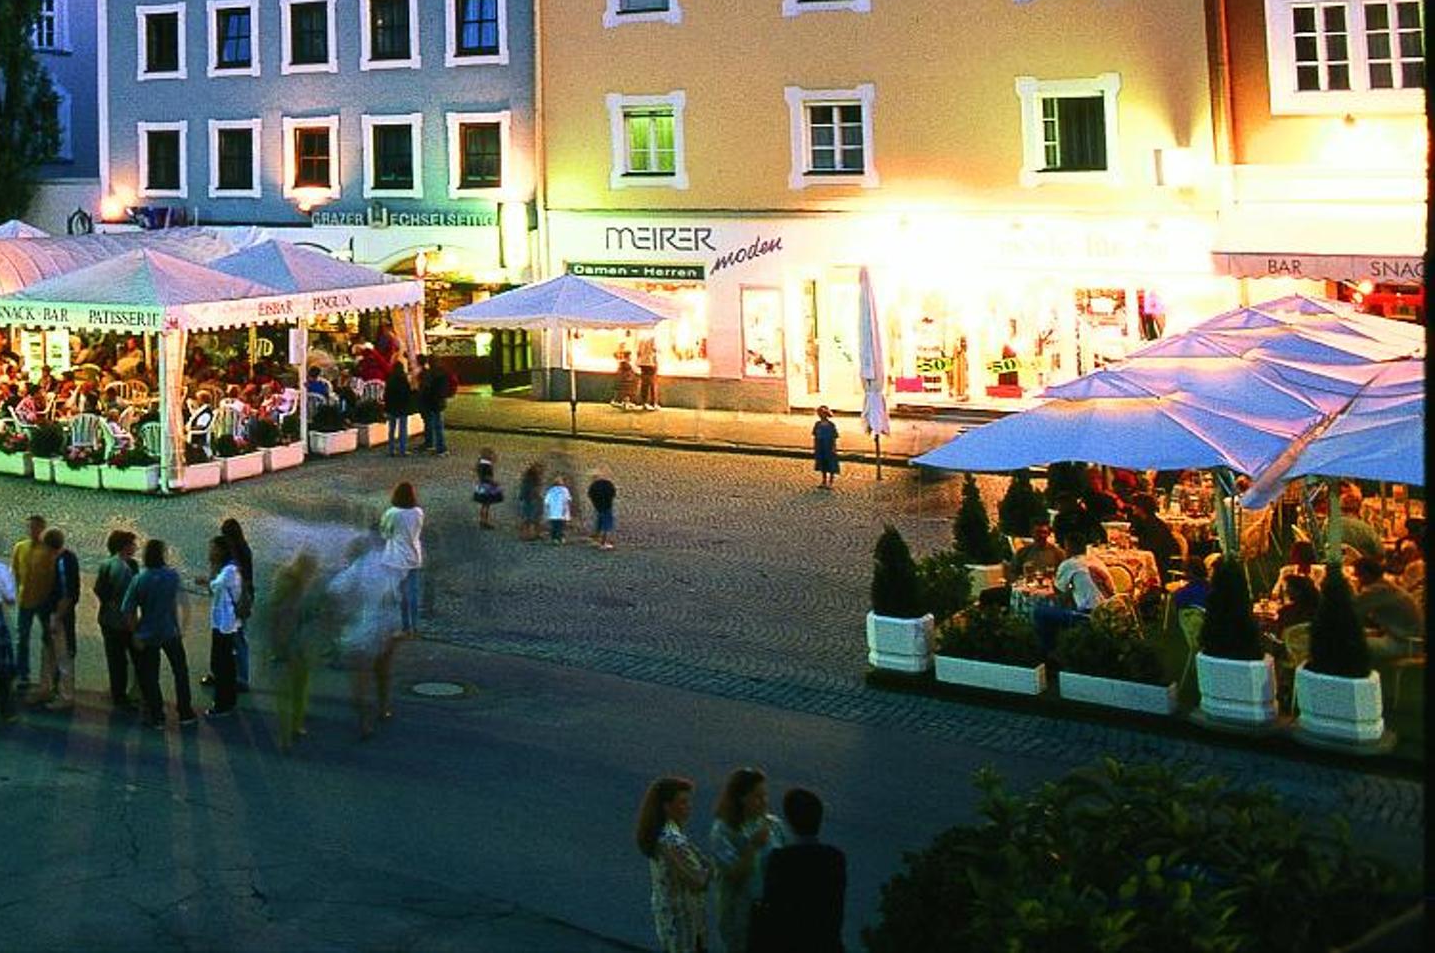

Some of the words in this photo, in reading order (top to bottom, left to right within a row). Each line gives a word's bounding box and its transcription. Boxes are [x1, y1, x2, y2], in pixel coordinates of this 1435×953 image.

[605, 227, 716, 251] MEIRER
[710, 235, 783, 275] moden
[573, 264, 628, 276] Damen
[643, 266, 698, 278] Herren
[1267, 259, 1302, 275] BAR
